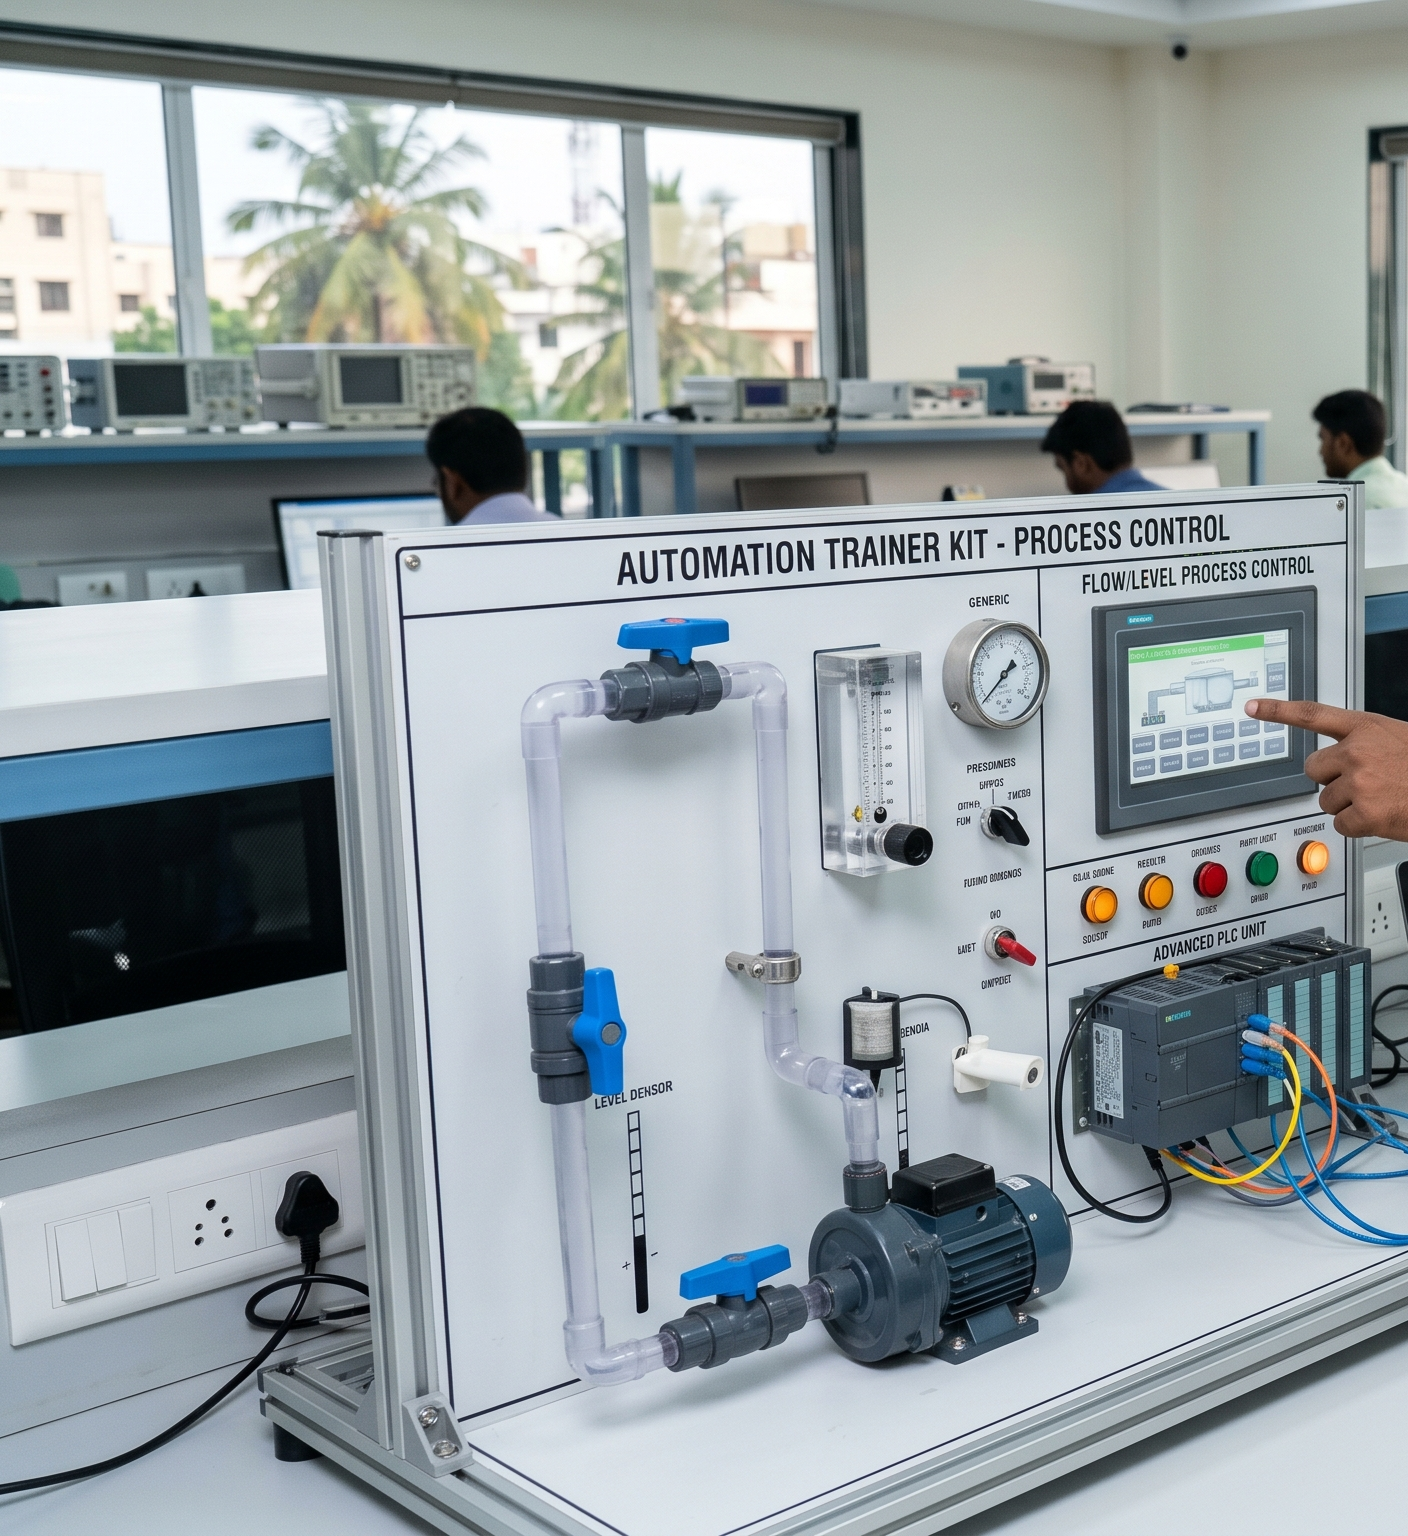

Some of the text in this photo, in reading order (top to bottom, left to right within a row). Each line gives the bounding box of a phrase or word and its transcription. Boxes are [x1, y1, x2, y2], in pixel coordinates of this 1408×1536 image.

[617, 540, 815, 586] AUTOMATION
[823, 531, 941, 570] TRAINER
[950, 528, 989, 562] KIT
[1014, 521, 1122, 557] PROCESS
[1130, 514, 1231, 547] CONTROL
[1082, 555, 1315, 594] FLOW/LEVEL PROCESS CONTROL
[969, 594, 1010, 608] GENERIC
[1153, 920, 1267, 963] ADVANCED PLC UNIT
[595, 1091, 628, 1110] LEVEL
